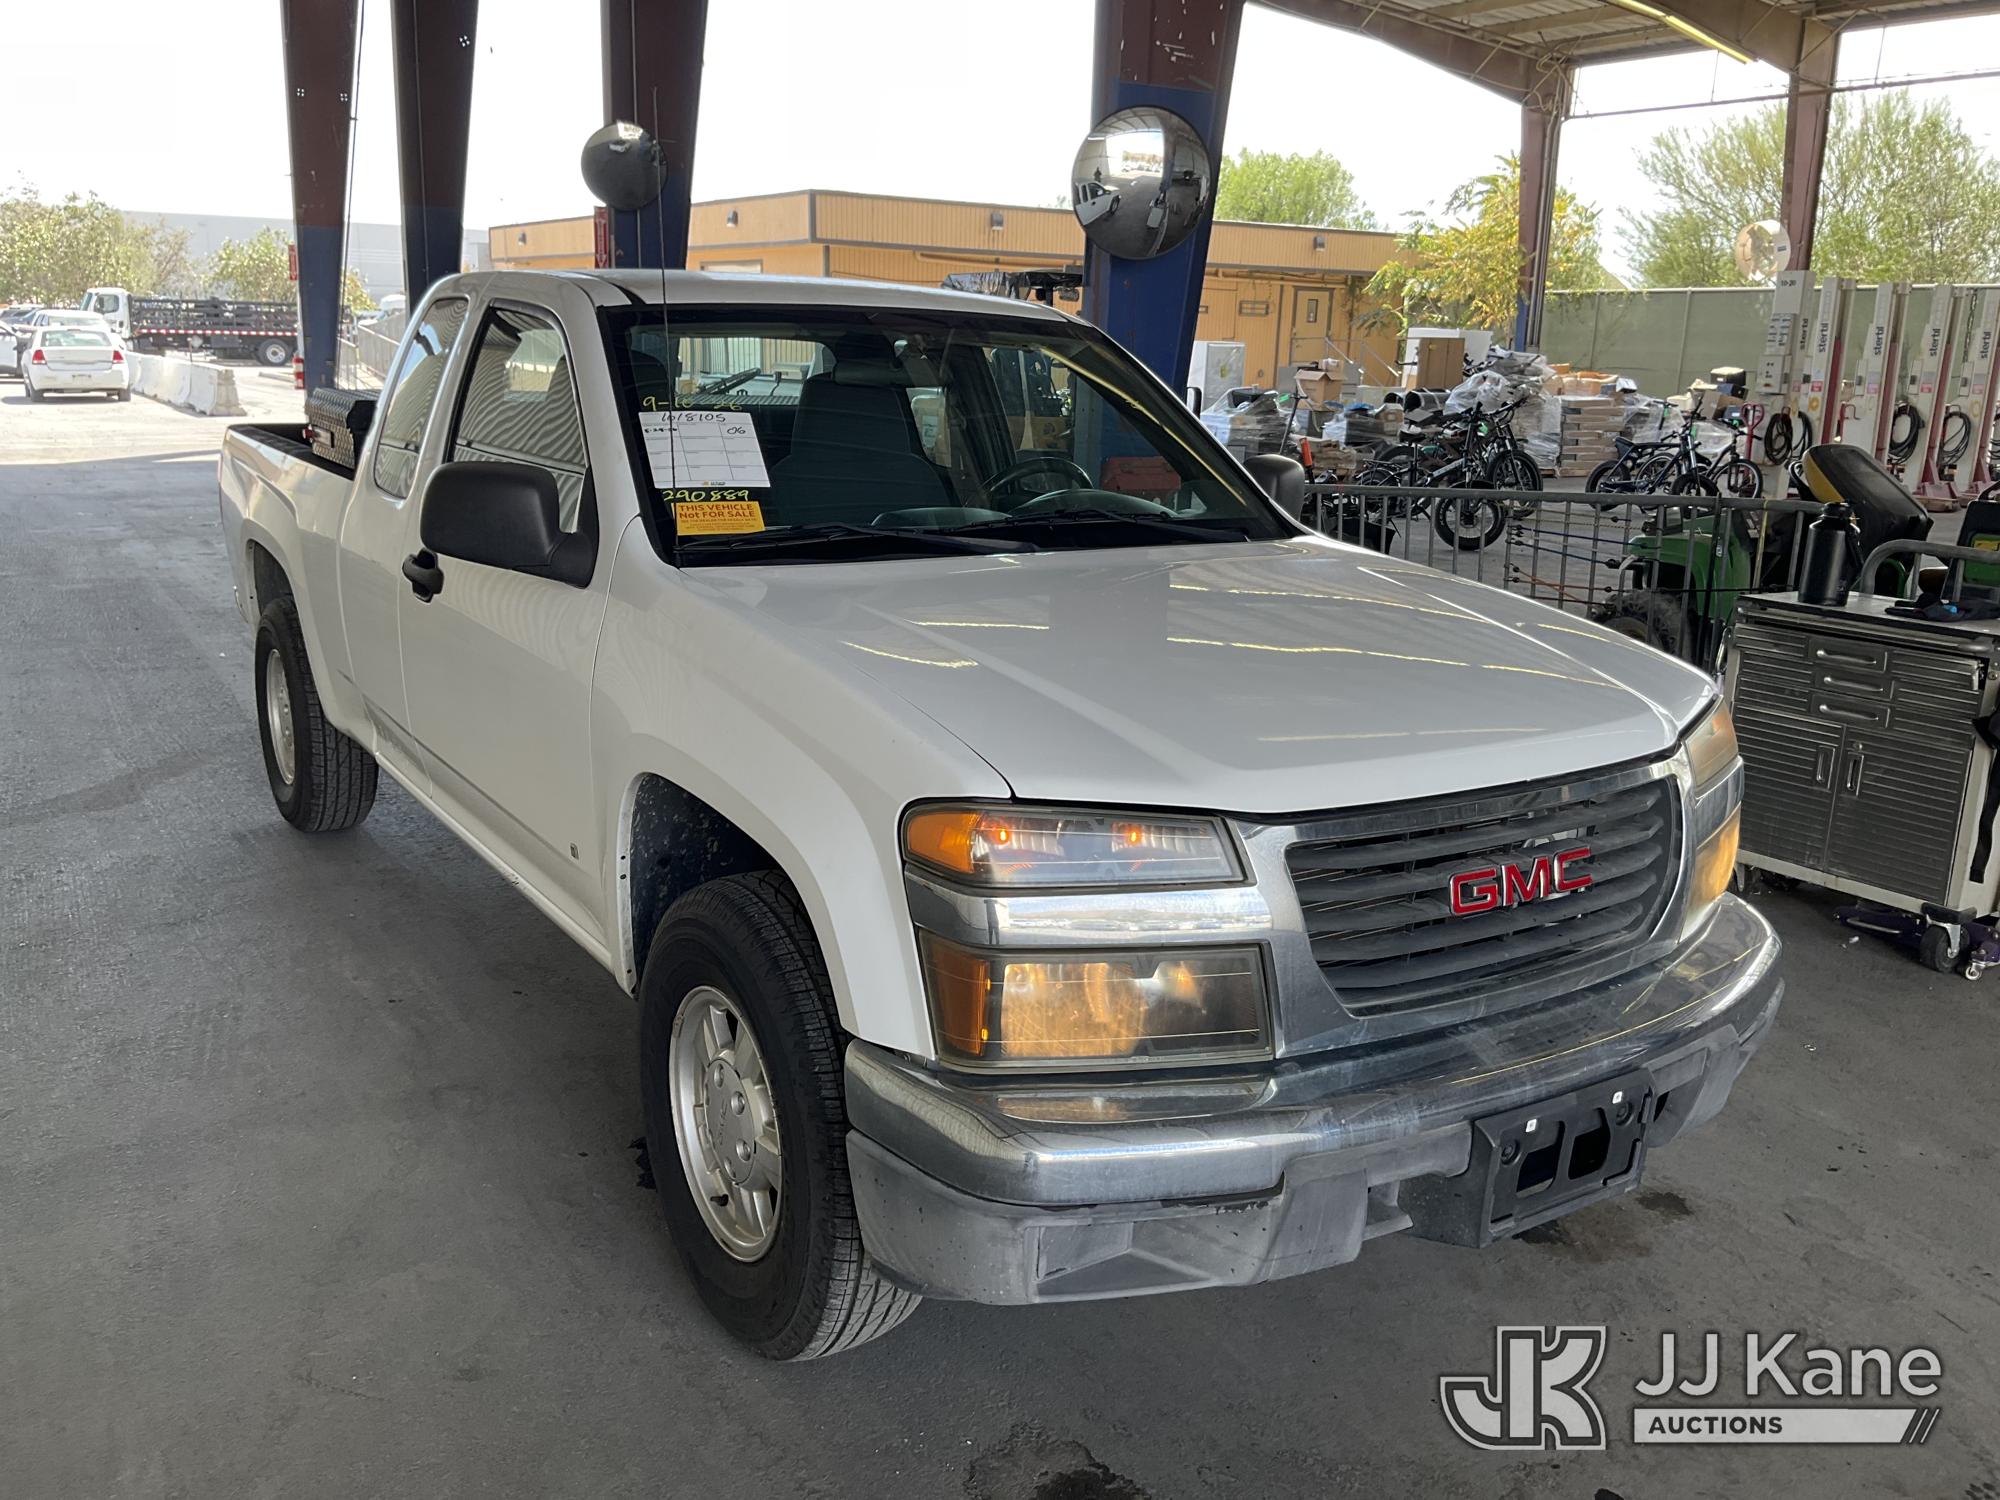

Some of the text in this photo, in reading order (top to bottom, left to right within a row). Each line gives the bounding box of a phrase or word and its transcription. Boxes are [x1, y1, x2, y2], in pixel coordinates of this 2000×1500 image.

[680, 503, 753, 512] THIS VEHICLE
[727, 510, 755, 518] SALE
[1449, 847, 1593, 916] GMC
